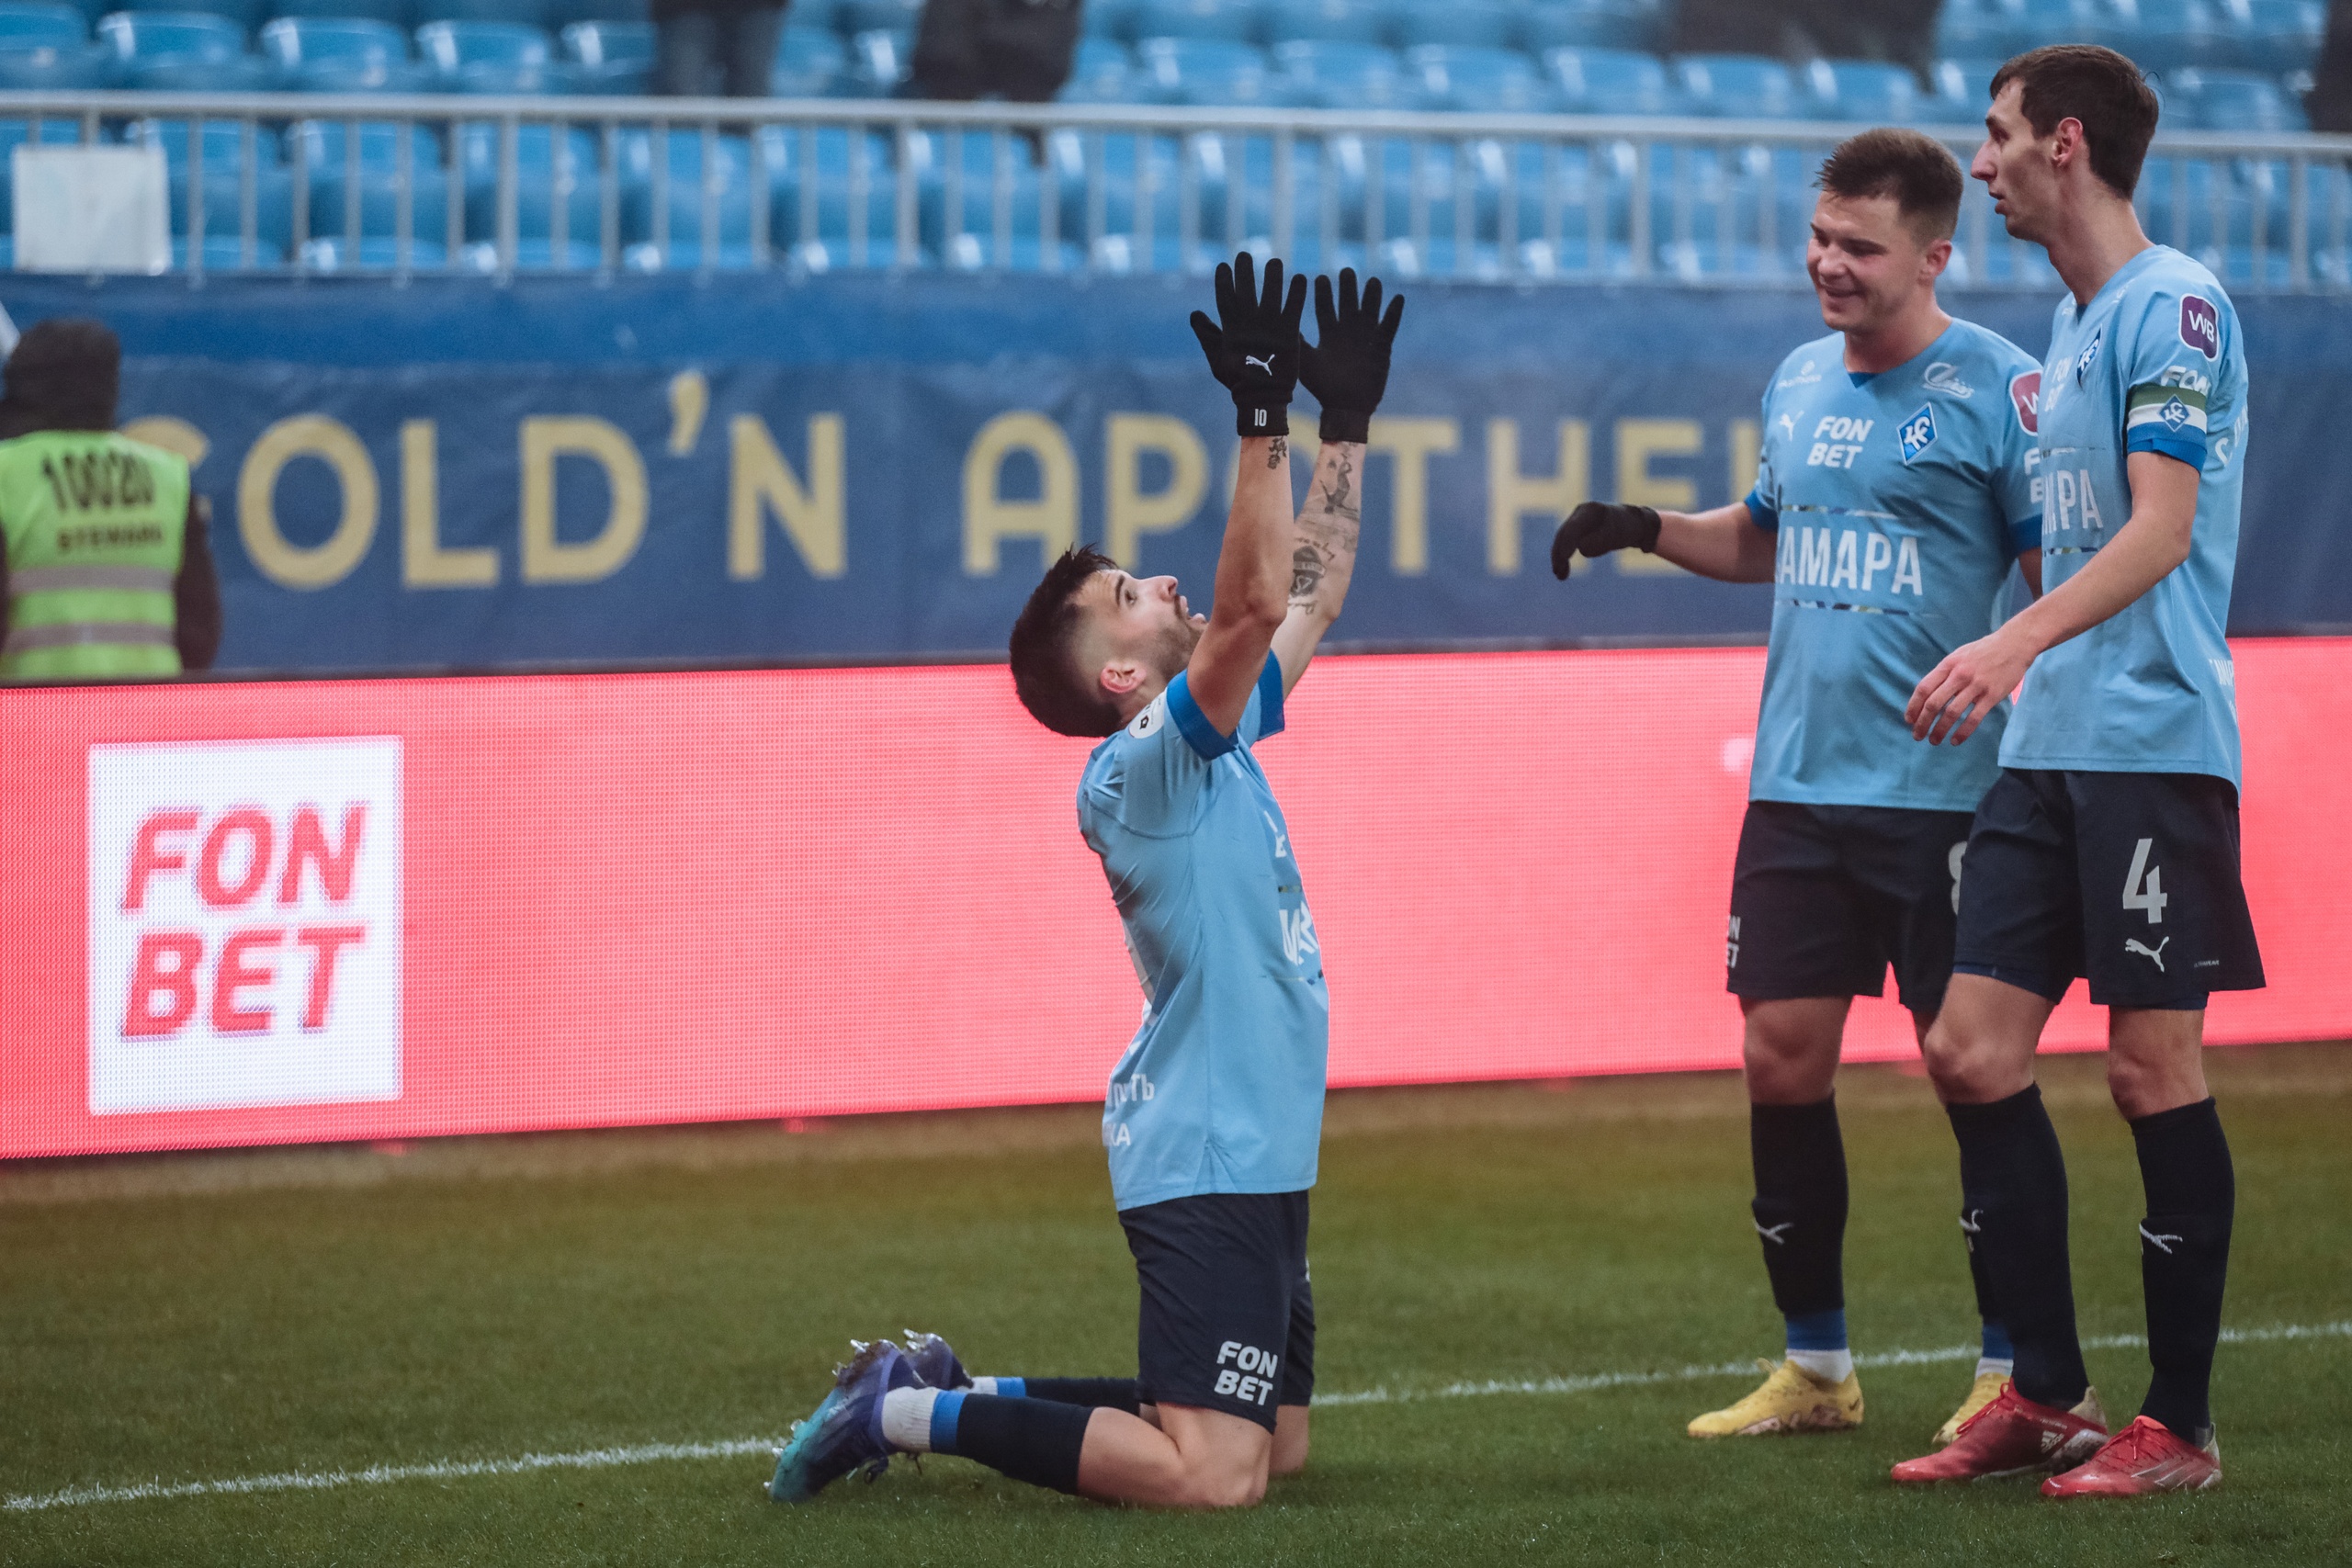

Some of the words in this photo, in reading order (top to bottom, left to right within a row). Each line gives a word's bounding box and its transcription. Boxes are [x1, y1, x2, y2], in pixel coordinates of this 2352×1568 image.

[1254, 409, 1267, 427] 10
[1814, 416, 1874, 443] FON
[1807, 443, 1863, 469] BET
[962, 410, 1763, 578] APTHE
[1776, 525, 1923, 596] АМАРА
[119, 798, 370, 913] FON
[2122, 838, 2168, 924] 4
[119, 924, 369, 1041] BET
[1214, 1369, 1274, 1405] BET
[1216, 1340, 1279, 1379] FON
